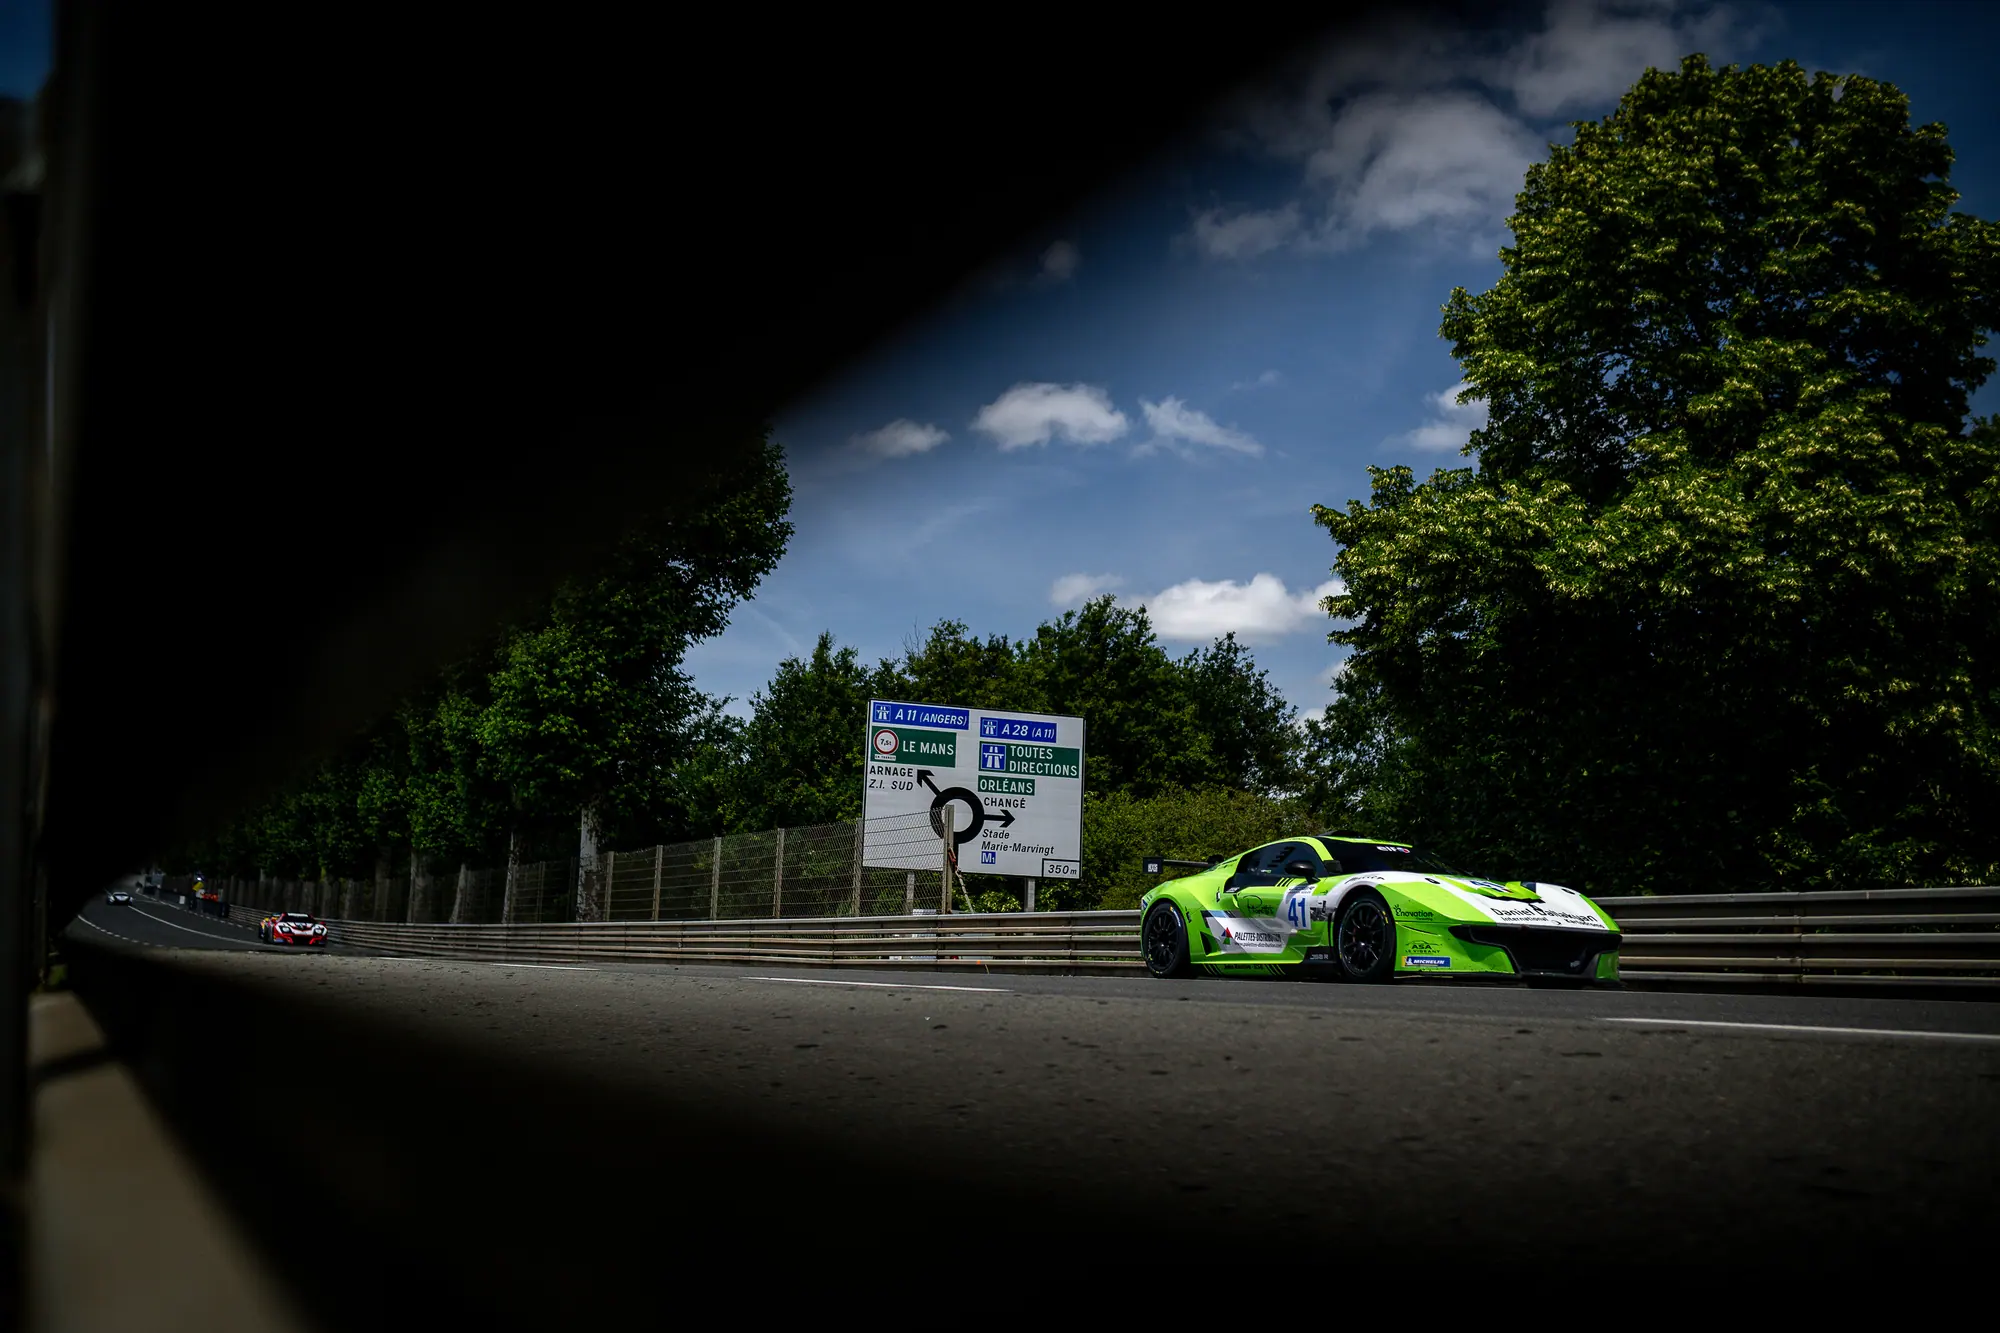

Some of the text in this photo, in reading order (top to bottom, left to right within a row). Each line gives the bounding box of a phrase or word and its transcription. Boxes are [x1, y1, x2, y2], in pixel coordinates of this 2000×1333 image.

[895, 708, 967, 726] A 11 (ANGERS)
[1001, 723, 1010, 735] A
[1012, 724, 1029, 736] 28
[902, 740, 954, 756] LE MANS
[1010, 745, 1053, 760] TOUTES
[869, 765, 914, 777] ARNAGE
[1009, 760, 1078, 777] DIRECTIONS
[868, 779, 914, 791] Z.I. SUD
[980, 778, 1033, 794] ORLÉANS
[983, 797, 1026, 809] CHANGÉ
[982, 828, 1010, 839] Stade
[981, 841, 1054, 856] Marie-Marvingt
[1048, 864, 1069, 874] 350
[1287, 897, 1307, 928] 41
[1490, 907, 1536, 916] Daniel
